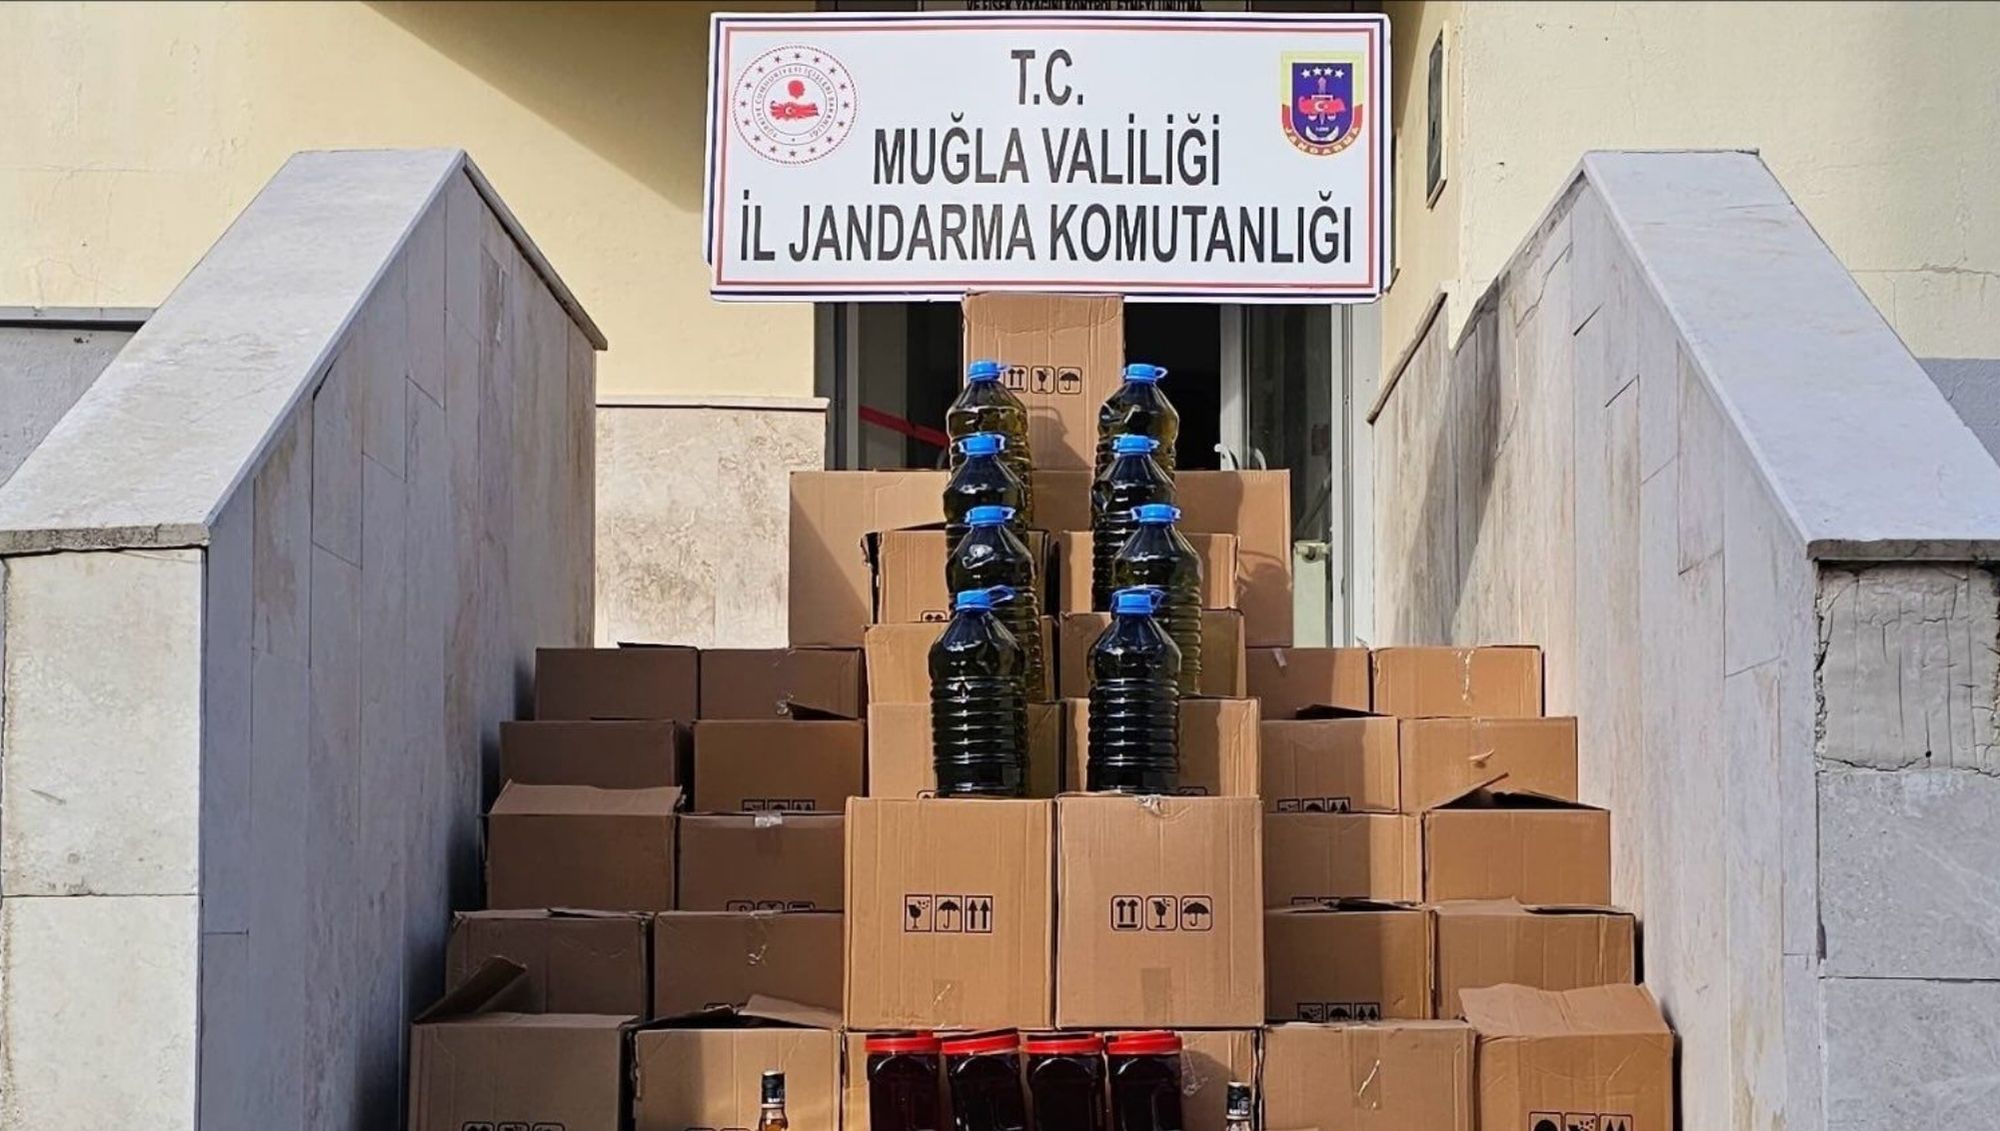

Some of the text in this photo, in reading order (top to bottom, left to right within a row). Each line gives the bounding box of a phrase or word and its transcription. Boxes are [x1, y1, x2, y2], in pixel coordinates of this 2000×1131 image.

[1011, 49, 1084, 106] T.C.
[874, 112, 1220, 186] MUĞLA VALİLİĞİ
[1285, 127, 1360, 155] JANDARMA
[741, 189, 1352, 264] İL JANDARMA KOMUTANLIĞI
